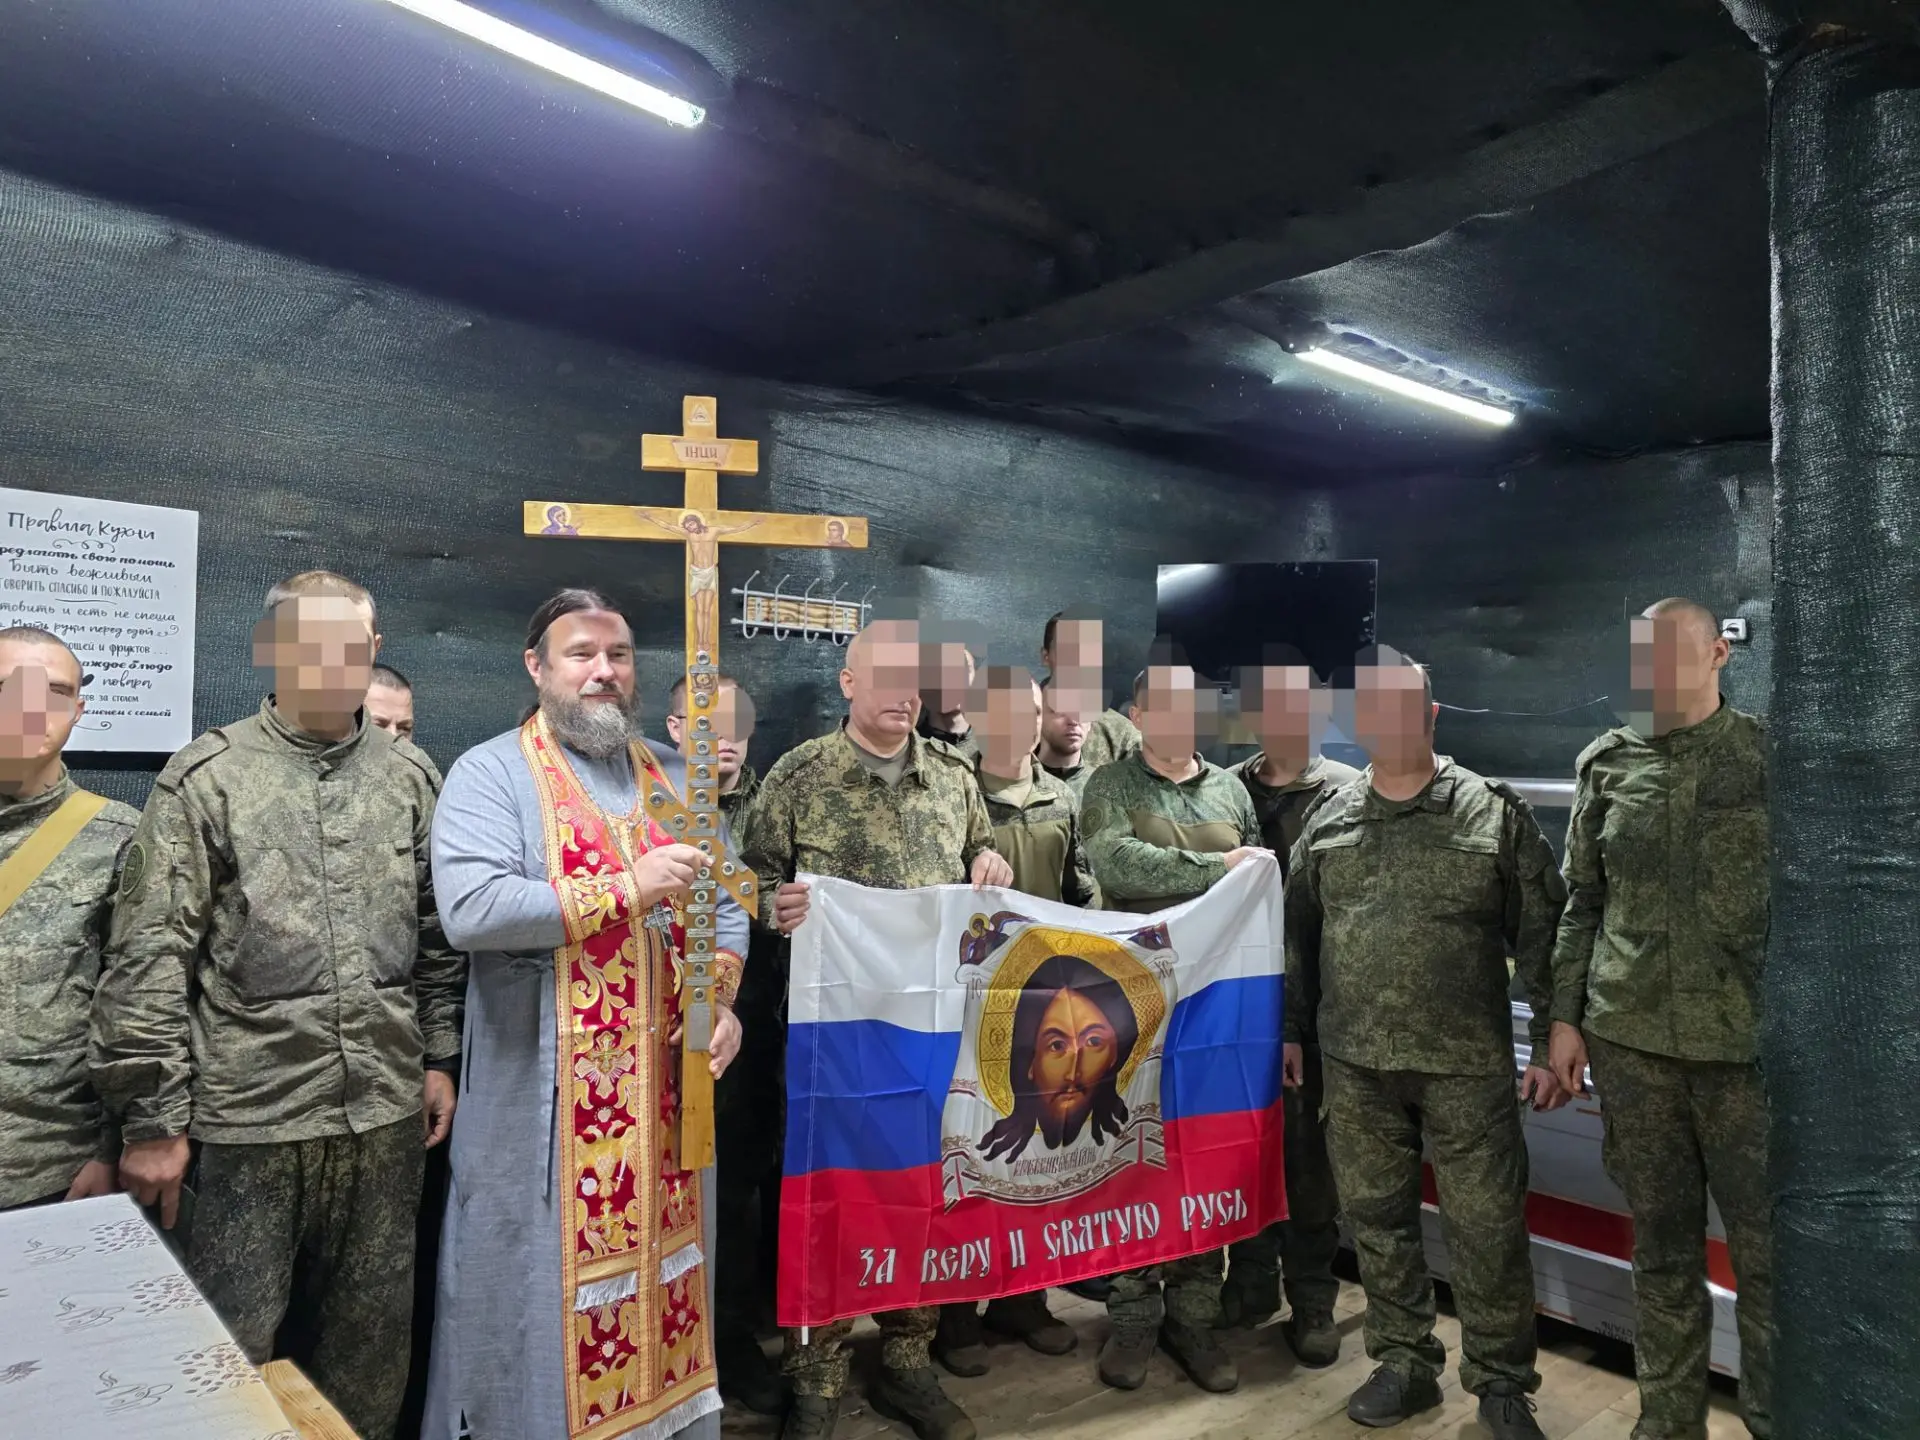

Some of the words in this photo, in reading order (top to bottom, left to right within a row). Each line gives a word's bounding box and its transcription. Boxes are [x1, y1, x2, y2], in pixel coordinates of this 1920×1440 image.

[8, 507, 95, 536] Правила
[98, 520, 156, 543] Кухни
[0, 546, 78, 559] редлагать
[81, 552, 117, 562] свою
[119, 557, 176, 568] помощь
[9, 558, 58, 576] Быть
[66, 563, 152, 584] вежливым
[48, 581, 88, 595] СПАСИБО
[91, 584, 98, 595] И
[101, 585, 160, 600] ПОЖАЛУЙСТА
[0, 600, 55, 614] товить
[62, 607, 71, 616] и
[77, 607, 108, 618] есть
[114, 609, 130, 619] не
[134, 610, 177, 622] спеша
[53, 622, 85, 636] руки
[89, 624, 122, 639] перед
[126, 626, 154, 640] едой
[109, 643, 151, 657] фруктов
[82, 660, 126, 671] аждое
[128, 660, 173, 673] блюдо
[102, 669, 152, 689] повара
[858, 1246, 898, 1287] ЗА
[920, 1236, 992, 1284] ВЕРУ
[1008, 1228, 1029, 1269] И
[1043, 1203, 1162, 1261] СВЯТУЮ
[1180, 1188, 1249, 1233] РУСЬ
